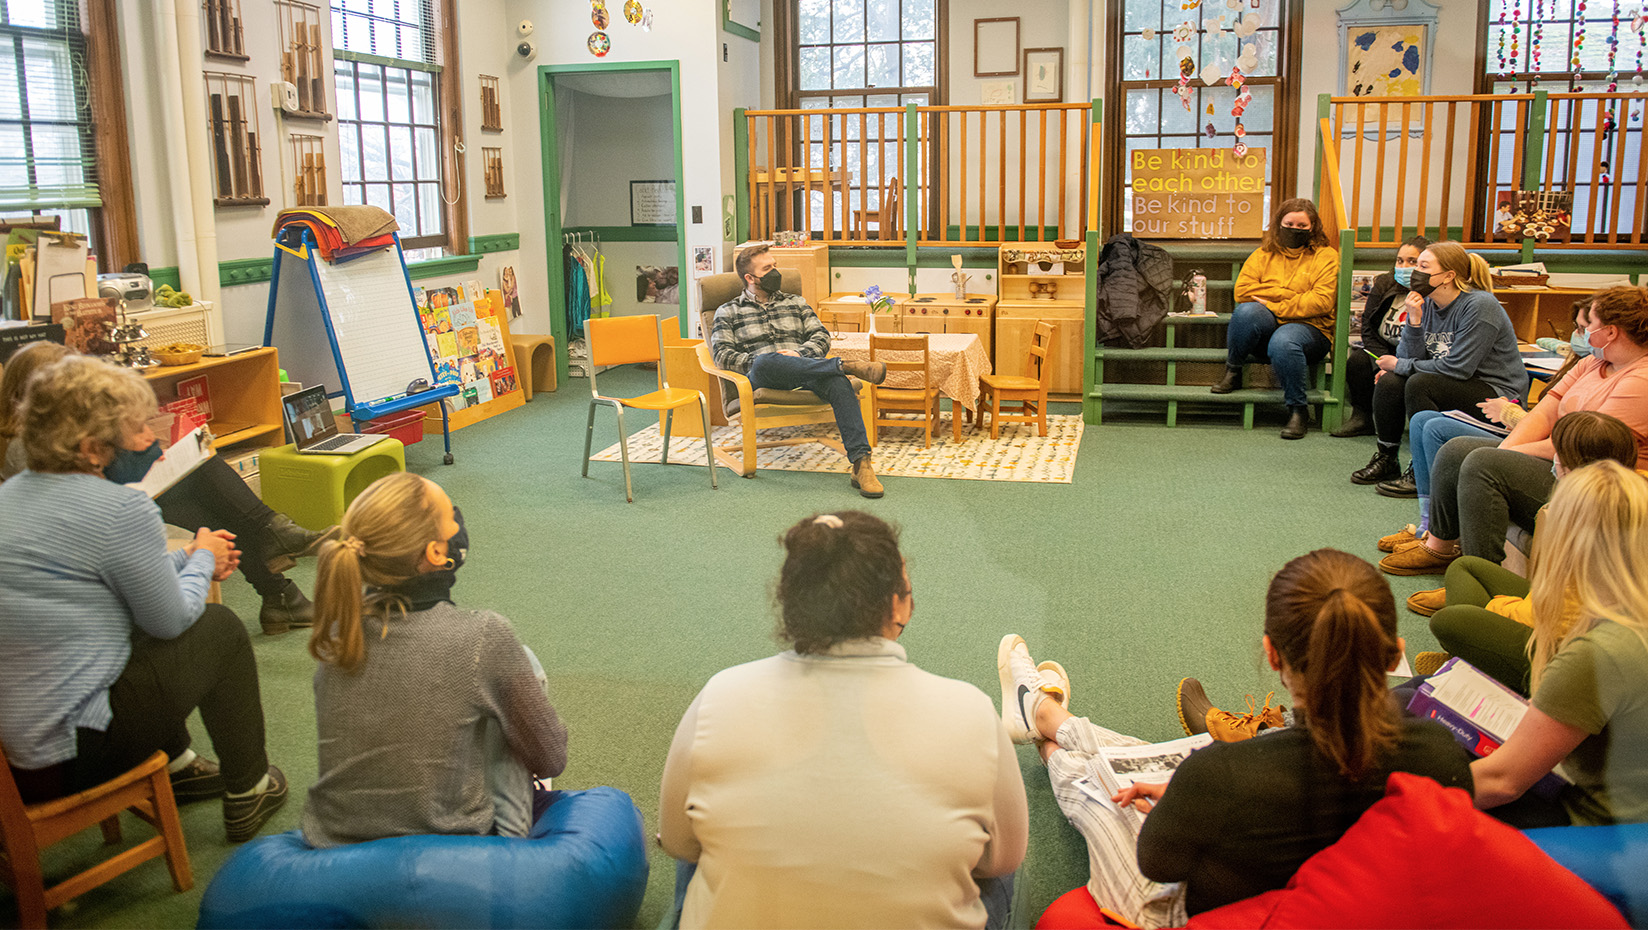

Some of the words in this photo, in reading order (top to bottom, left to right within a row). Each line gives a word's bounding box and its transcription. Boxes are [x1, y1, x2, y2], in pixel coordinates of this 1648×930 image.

[1133, 151, 1162, 170] Be
[1171, 149, 1224, 170] kind
[1132, 173, 1192, 192] each
[1201, 171, 1264, 191] other
[1135, 196, 1162, 214] Be
[1168, 195, 1217, 214] kind
[1226, 194, 1251, 214] to
[1133, 219, 1170, 233] our
[1179, 215, 1235, 235] stuff
[1437, 714, 1473, 741] Heavy-Duty
